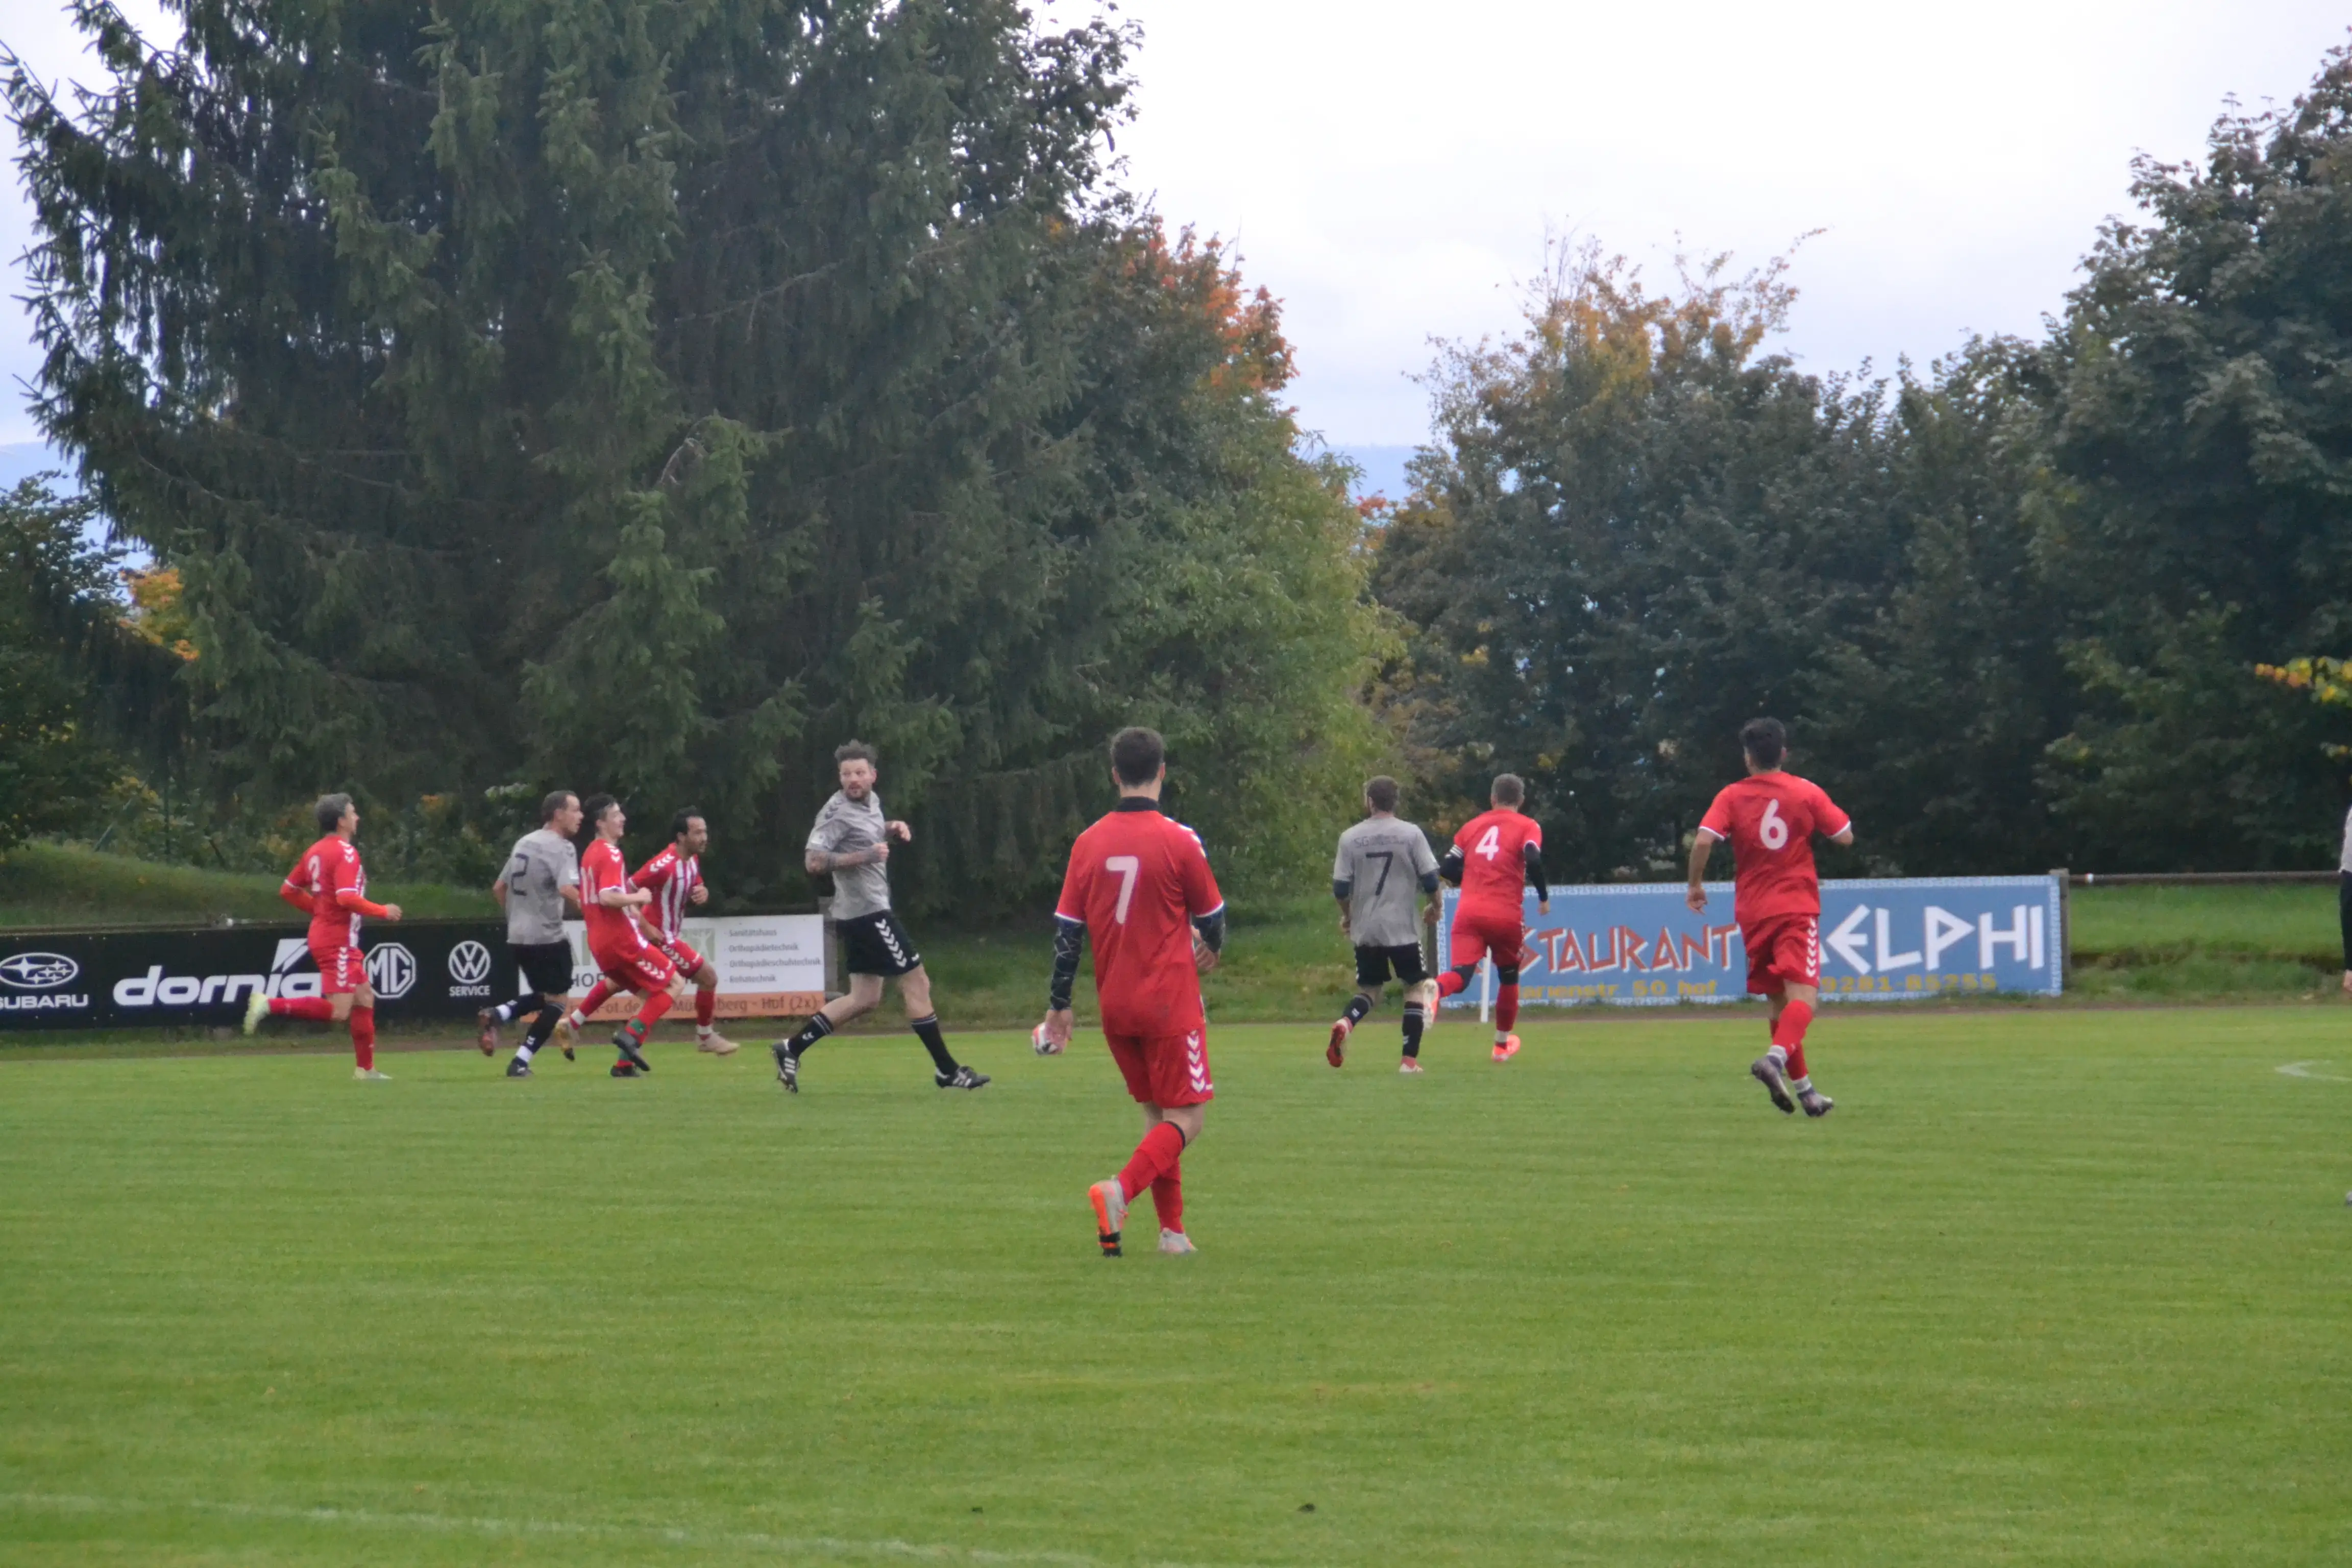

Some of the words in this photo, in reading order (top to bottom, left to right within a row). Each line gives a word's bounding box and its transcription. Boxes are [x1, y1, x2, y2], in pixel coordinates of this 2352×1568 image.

[1475, 825, 1500, 861] 4
[1760, 798, 1788, 850] 6
[308, 854, 321, 892] 2
[511, 852, 529, 896] 2
[1105, 855, 1139, 924] 7
[1366, 851, 1393, 896] 7
[1475, 923, 1739, 974] STAURANT
[1819, 903, 2044, 974] ELPHI
[366, 947, 411, 993] MG
[449, 985, 491, 996] SERVICE
[761, 995, 785, 1009] Hof
